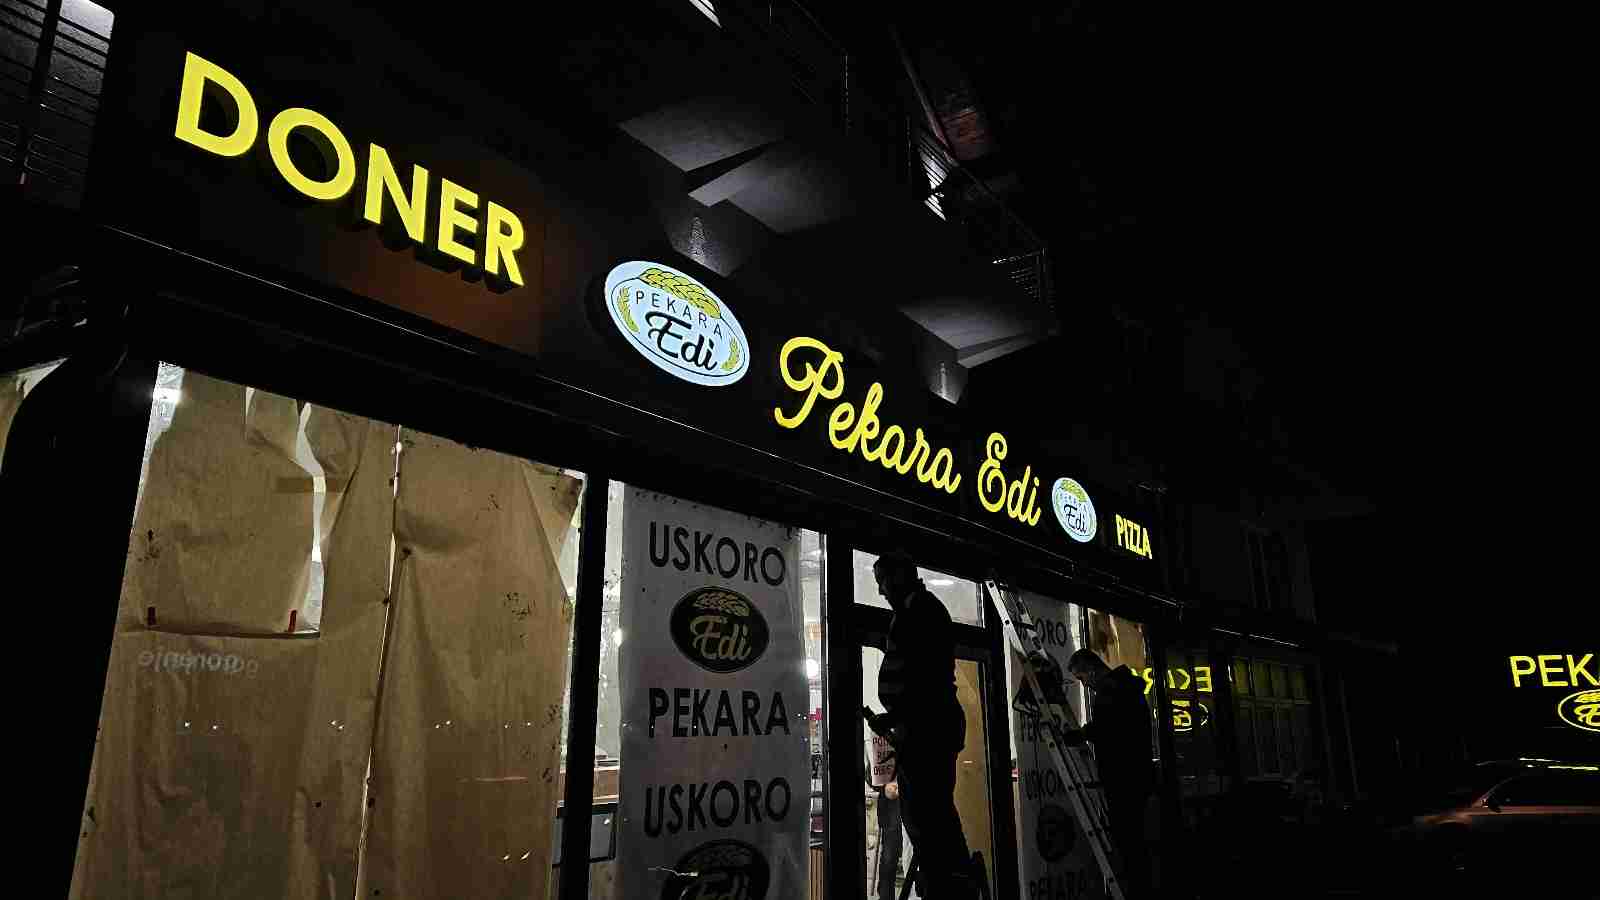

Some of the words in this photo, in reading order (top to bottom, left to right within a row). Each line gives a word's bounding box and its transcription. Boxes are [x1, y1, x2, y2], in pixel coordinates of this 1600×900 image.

[174, 50, 525, 287] DONER
[635, 289, 723, 341] PEKARA
[645, 310, 718, 371] Edi
[774, 335, 962, 495] Pekara
[976, 431, 1042, 528] Edi
[1063, 503, 1088, 535] Edi
[1115, 513, 1153, 560] PIZZA
[649, 520, 787, 587] USKORO
[689, 614, 752, 661] Edi
[1509, 653, 1600, 688] PEK
[648, 687, 792, 738] PEKARA
[643, 776, 793, 839] USKORO
